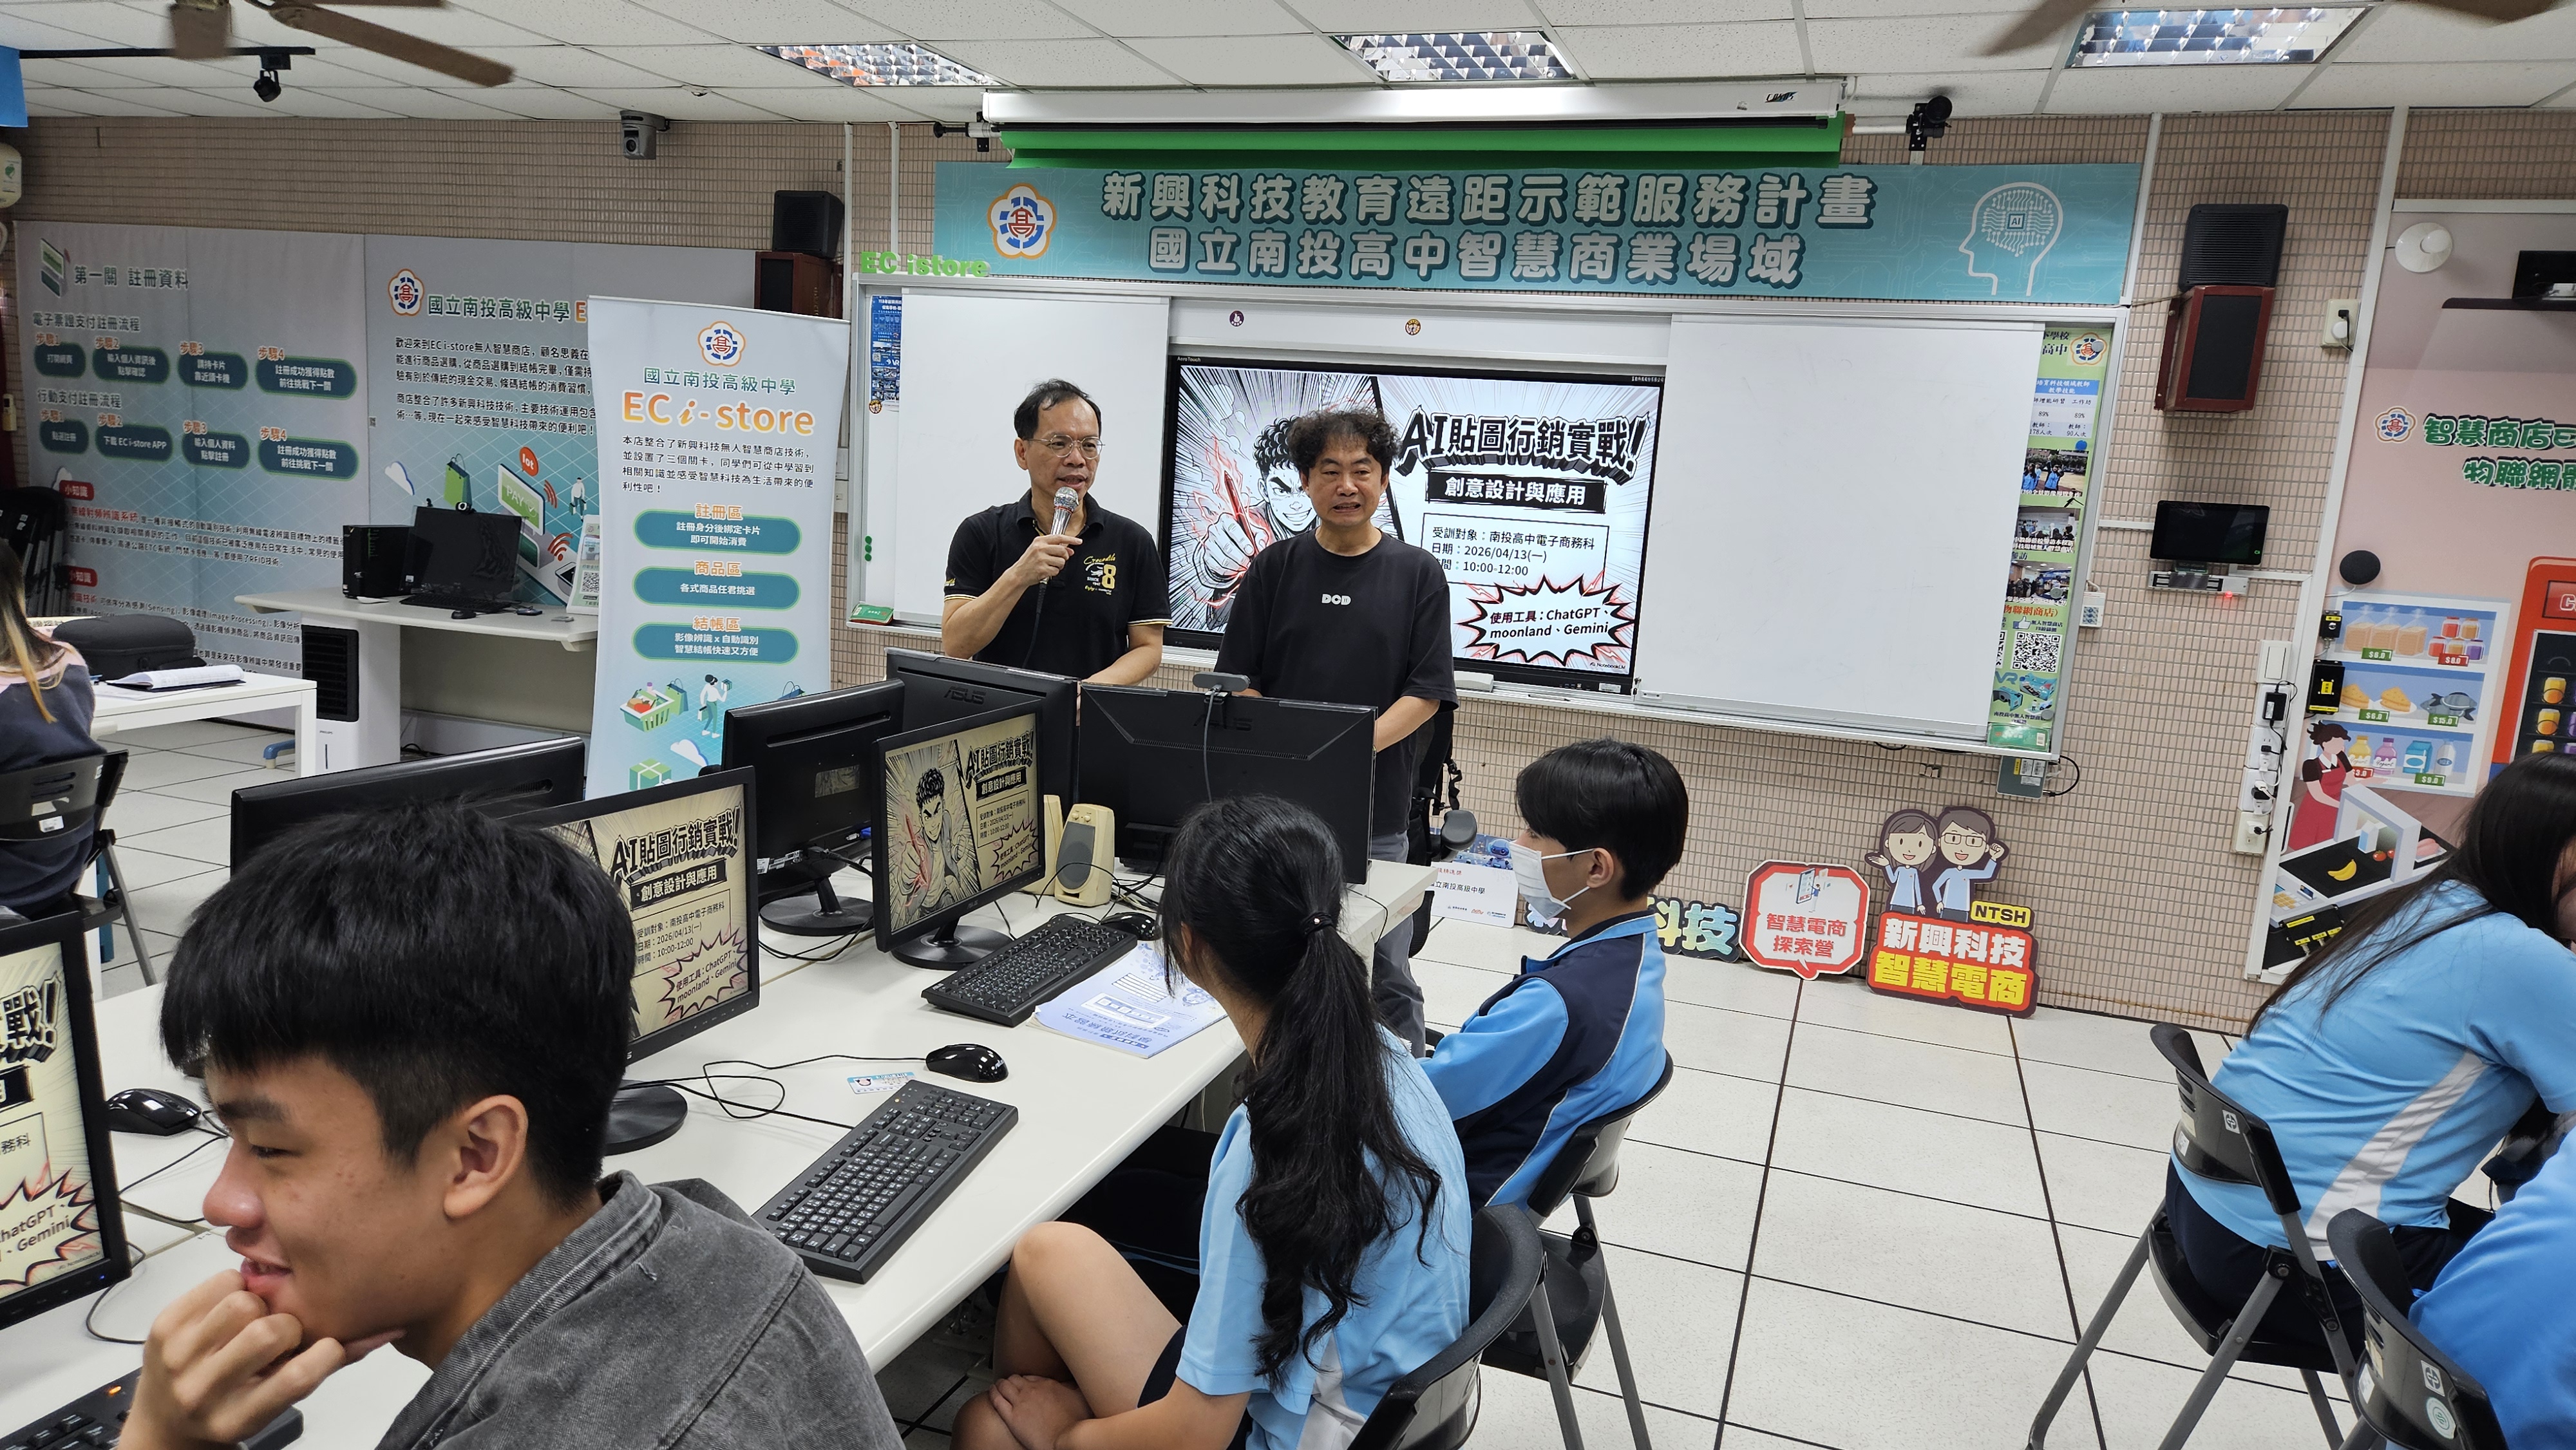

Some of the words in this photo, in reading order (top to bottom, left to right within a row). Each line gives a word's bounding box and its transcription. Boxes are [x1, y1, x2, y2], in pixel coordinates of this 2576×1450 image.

[1102, 171, 1875, 227] 新興科技教育遠距示範服務計畫
[860, 250, 898, 274] EC
[907, 253, 990, 278] istore
[1149, 227, 1805, 286] 國立南投高中智慧商業場域
[74, 266, 117, 286] 第一關
[128, 268, 188, 289] 註冊資料
[428, 295, 570, 323] 國立南投高級中學
[33, 312, 140, 332] 電子票證支付註冊流程
[95, 336, 119, 349] 步驟2
[180, 341, 204, 355] 步驟3
[2041, 343, 2068, 356] 高中
[258, 346, 285, 361] 步驟4
[275, 364, 335, 379] 註冊成功獲得點數
[643, 366, 796, 395] 國立南投高級中學
[279, 378, 331, 391] 前往挑戰下一關
[37, 389, 122, 408] 行動支付註冊流程
[623, 391, 671, 424] EC
[99, 413, 123, 427] 步驟2
[184, 420, 207, 435] 步驟3
[260, 426, 287, 441] 步驟4
[1399, 406, 1649, 478] AI貼圖行銷實戰!
[153, 441, 167, 449] APP
[194, 438, 235, 450] 輸入個人資料
[278, 445, 336, 459] 註冊成功獲得點數
[622, 434, 810, 458] 本店整合了新興科技無人智慧商店技術，
[281, 458, 334, 472] 前往挑戰下一關
[622, 450, 814, 474] 並設置了三個關卡，同學們可從中學習到
[622, 466, 814, 489] 相關知識並感受智慧科技為生活帶來的便
[506, 485, 524, 507] PAY
[622, 482, 662, 494] 利性吧！
[1444, 476, 1586, 505] 創意設計與應用
[695, 503, 744, 521] 註冊區
[676, 522, 761, 536] 註冊身分後綁定卡片
[690, 534, 747, 547] 即可開始消費
[1432, 527, 1595, 551] 受訓對象：南投高中電子商務科
[1432, 542, 1547, 563] 日期：2026/04/13(一)
[694, 560, 742, 578] 商品區
[1102, 564, 1117, 589] 8
[679, 583, 755, 596] 各式商品任君挑選
[692, 615, 741, 632] 結帳區
[1490, 607, 1609, 625] 使用工具：ChatGPT、
[674, 632, 713, 644] 影像辨識
[721, 634, 759, 645] 自動識別
[1490, 622, 1609, 639] moonland、Gemini
[674, 644, 759, 657] 智慧結帳快速又方便
[2369, 651, 2385, 660] $6.0
[943, 686, 987, 705] ASUS
[1993, 711, 2047, 720] 南投高中無人智慧商
[2365, 711, 2382, 720] $6.0
[2433, 715, 2453, 725] $15.0
[981, 771, 1022, 796] 創意設計與應用
[2421, 776, 2439, 784] $9.0
[611, 802, 743, 881] AI貼圖行銷實戰!
[640, 865, 717, 902] 創意設計與應用
[636, 901, 725, 939] 受訓對象：南投高中電子商務科
[1765, 912, 1848, 937] 智慧電商
[1975, 905, 2027, 925] NTSH
[637, 921, 703, 952] 日期：2026/04/13(一)
[1883, 918, 2027, 969] 新興科技
[637, 937, 694, 963] 時間：10:00-12:00
[1773, 934, 1834, 959] 探索營
[676, 958, 737, 1003] moonland、Gemini
[1874, 951, 2028, 1006] 智慧電商
